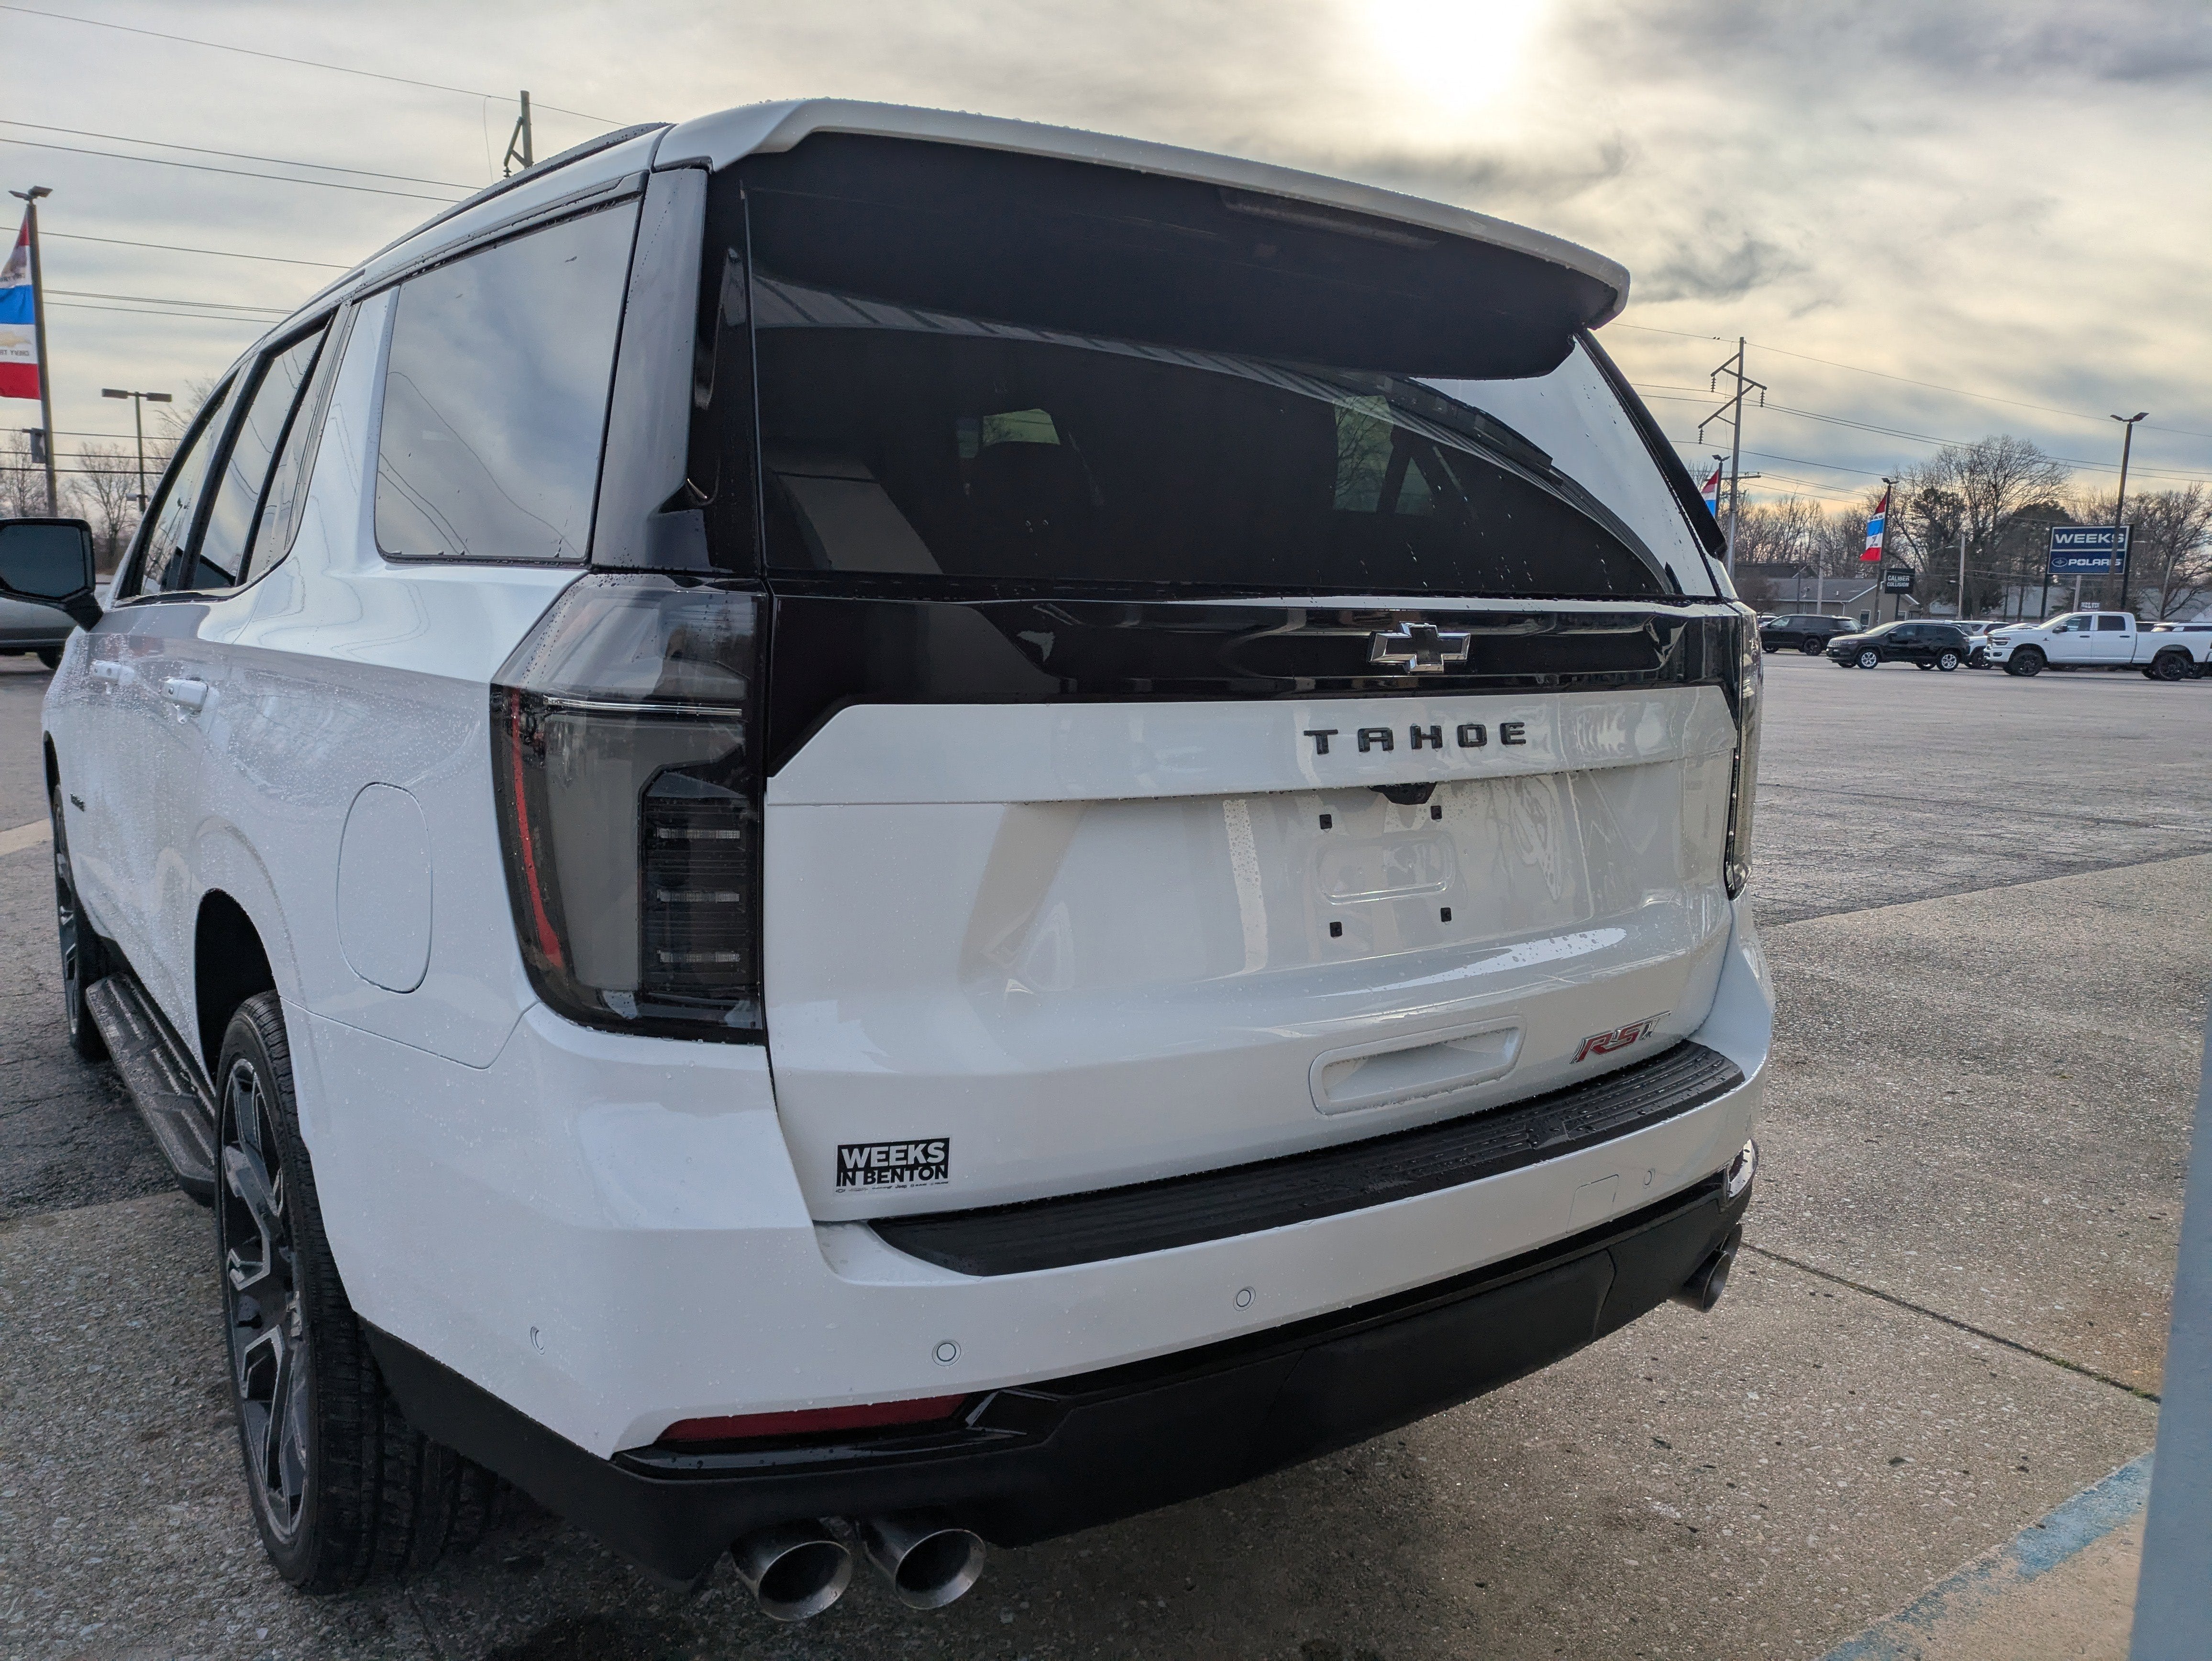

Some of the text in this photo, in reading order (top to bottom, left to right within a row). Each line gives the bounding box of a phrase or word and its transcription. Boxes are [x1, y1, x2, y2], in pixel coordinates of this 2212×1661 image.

[2055, 533, 2124, 543] WEEKS
[1304, 721, 1526, 755] TAHOE
[1569, 1010, 1672, 1064] RST
[841, 1141, 945, 1169] WEEKS
[836, 1165, 949, 1187] IN BENTON
